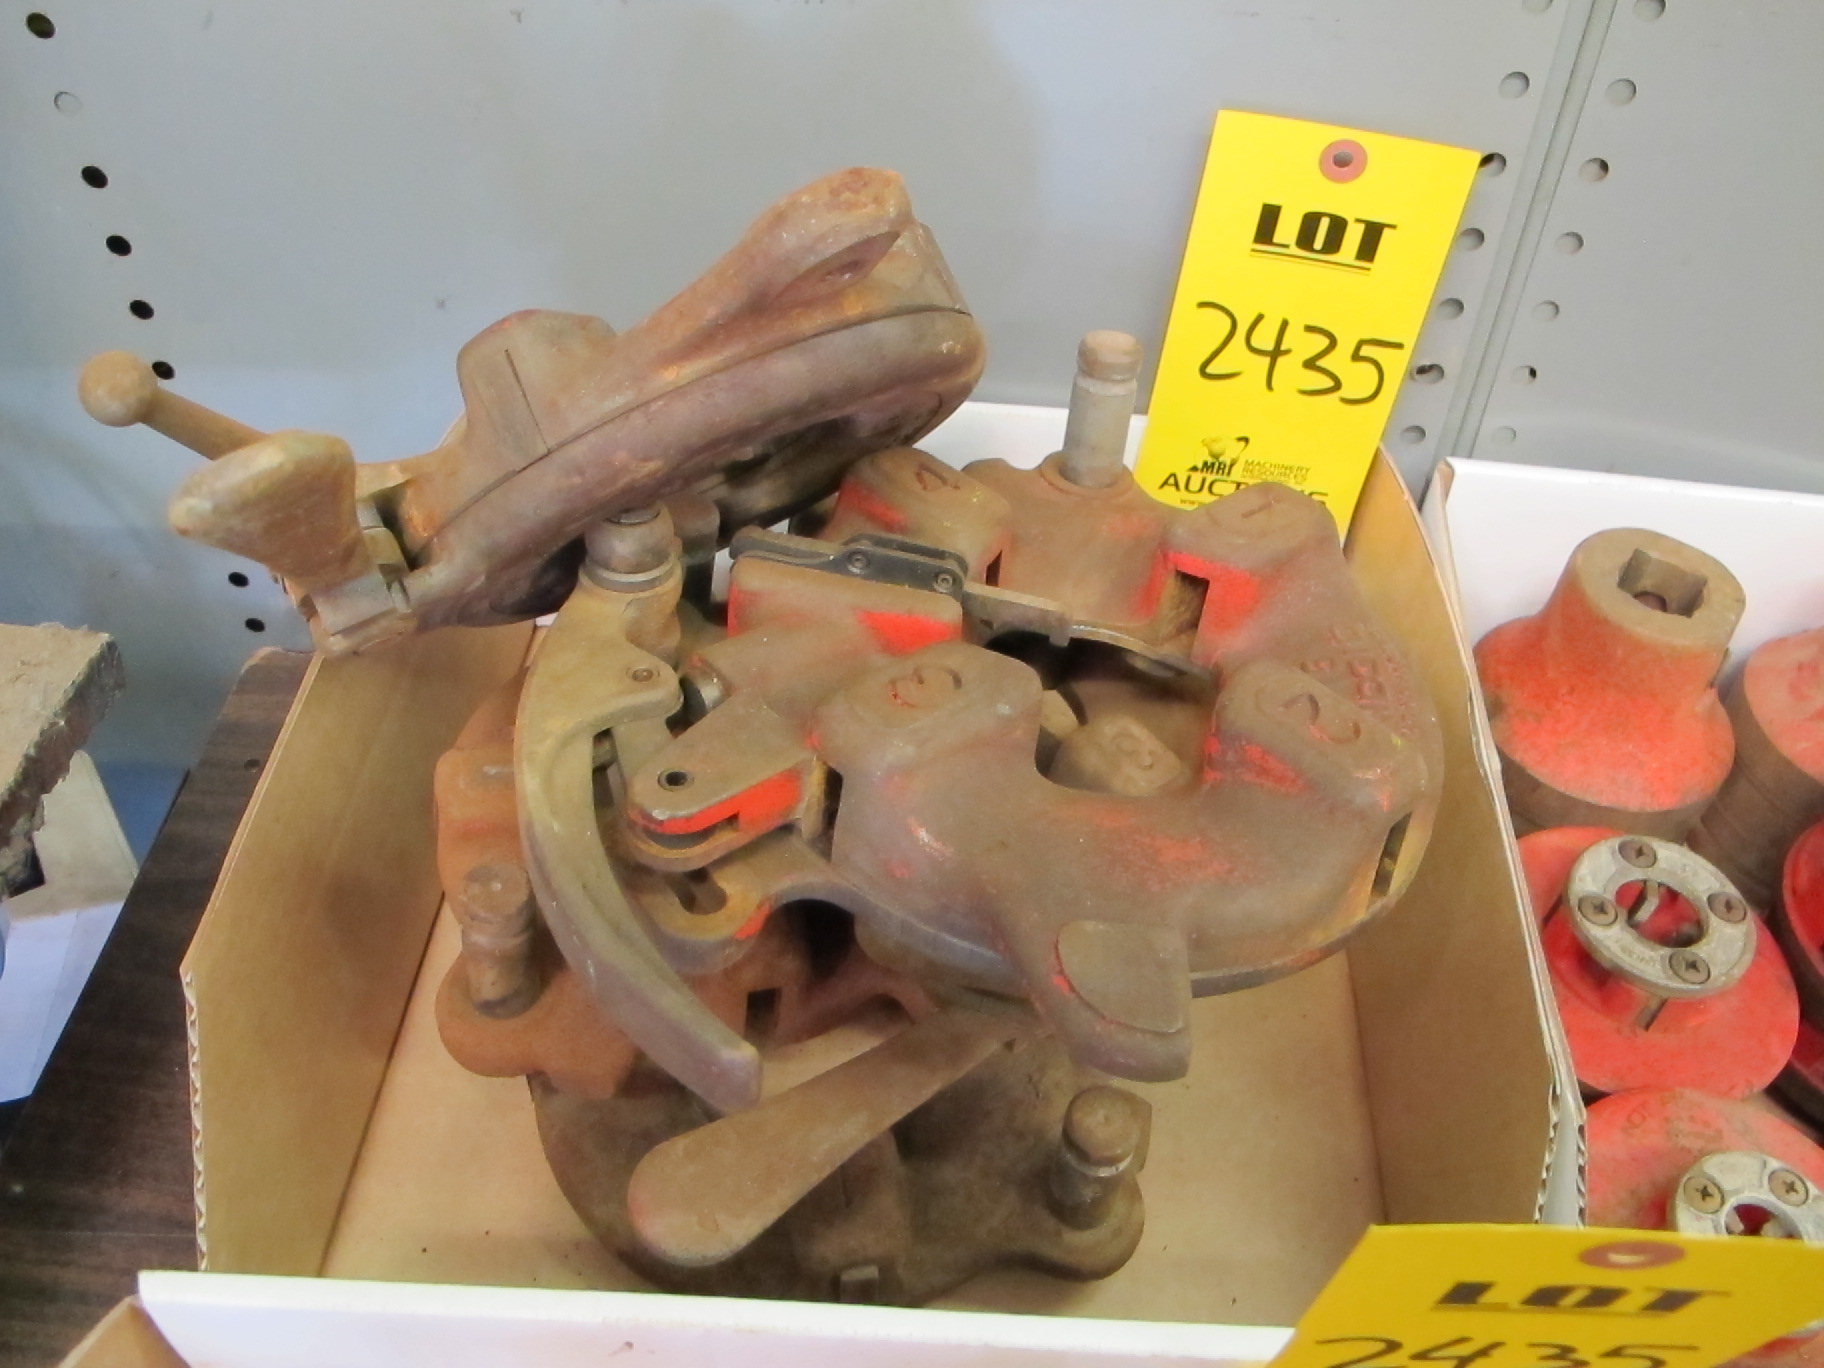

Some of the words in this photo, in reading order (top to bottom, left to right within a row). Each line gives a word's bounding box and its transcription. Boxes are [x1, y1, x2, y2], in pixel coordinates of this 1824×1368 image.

[1252, 203, 1397, 263] LOT
[1197, 302, 1404, 404] 2435
[1242, 468, 1308, 485] RESOURCES
[1243, 459, 1311, 475] MACHINERY
[1436, 1281, 1732, 1313] LOT
